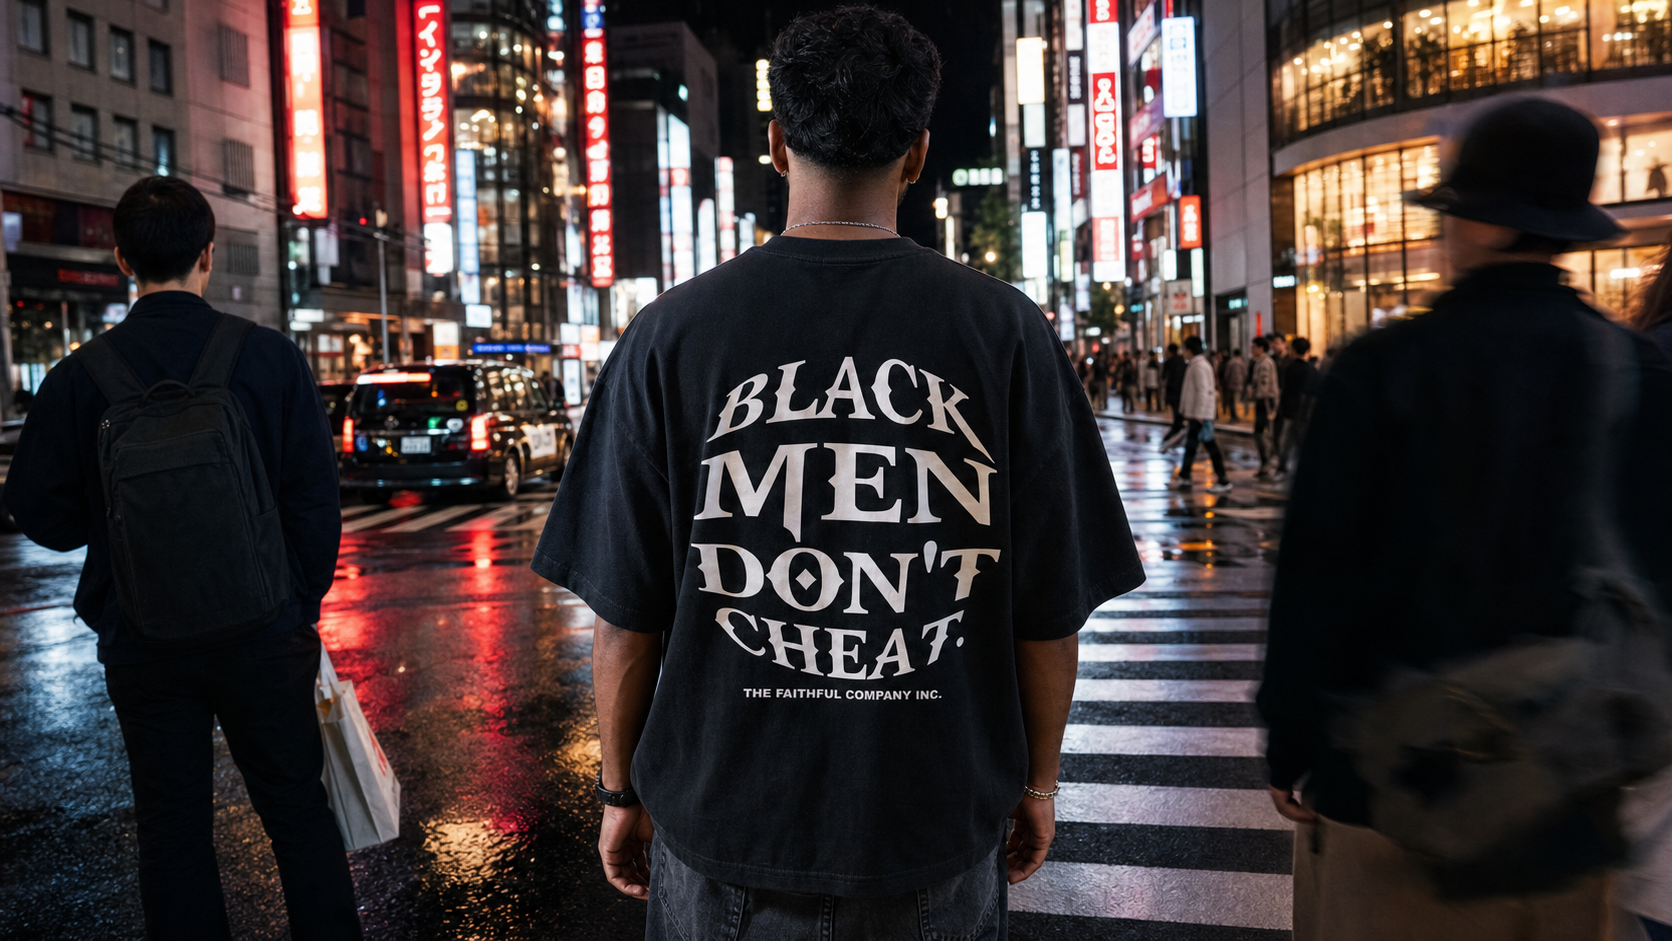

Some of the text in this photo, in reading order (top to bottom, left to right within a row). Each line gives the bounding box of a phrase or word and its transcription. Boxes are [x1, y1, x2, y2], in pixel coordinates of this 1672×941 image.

[706, 356, 995, 464] BLACK
[694, 442, 998, 543] MEN
[690, 540, 1001, 614] DON'T
[714, 607, 965, 680] CHEAT.
[743, 688, 943, 701] THE FAITHFUL COMPANY INC.
